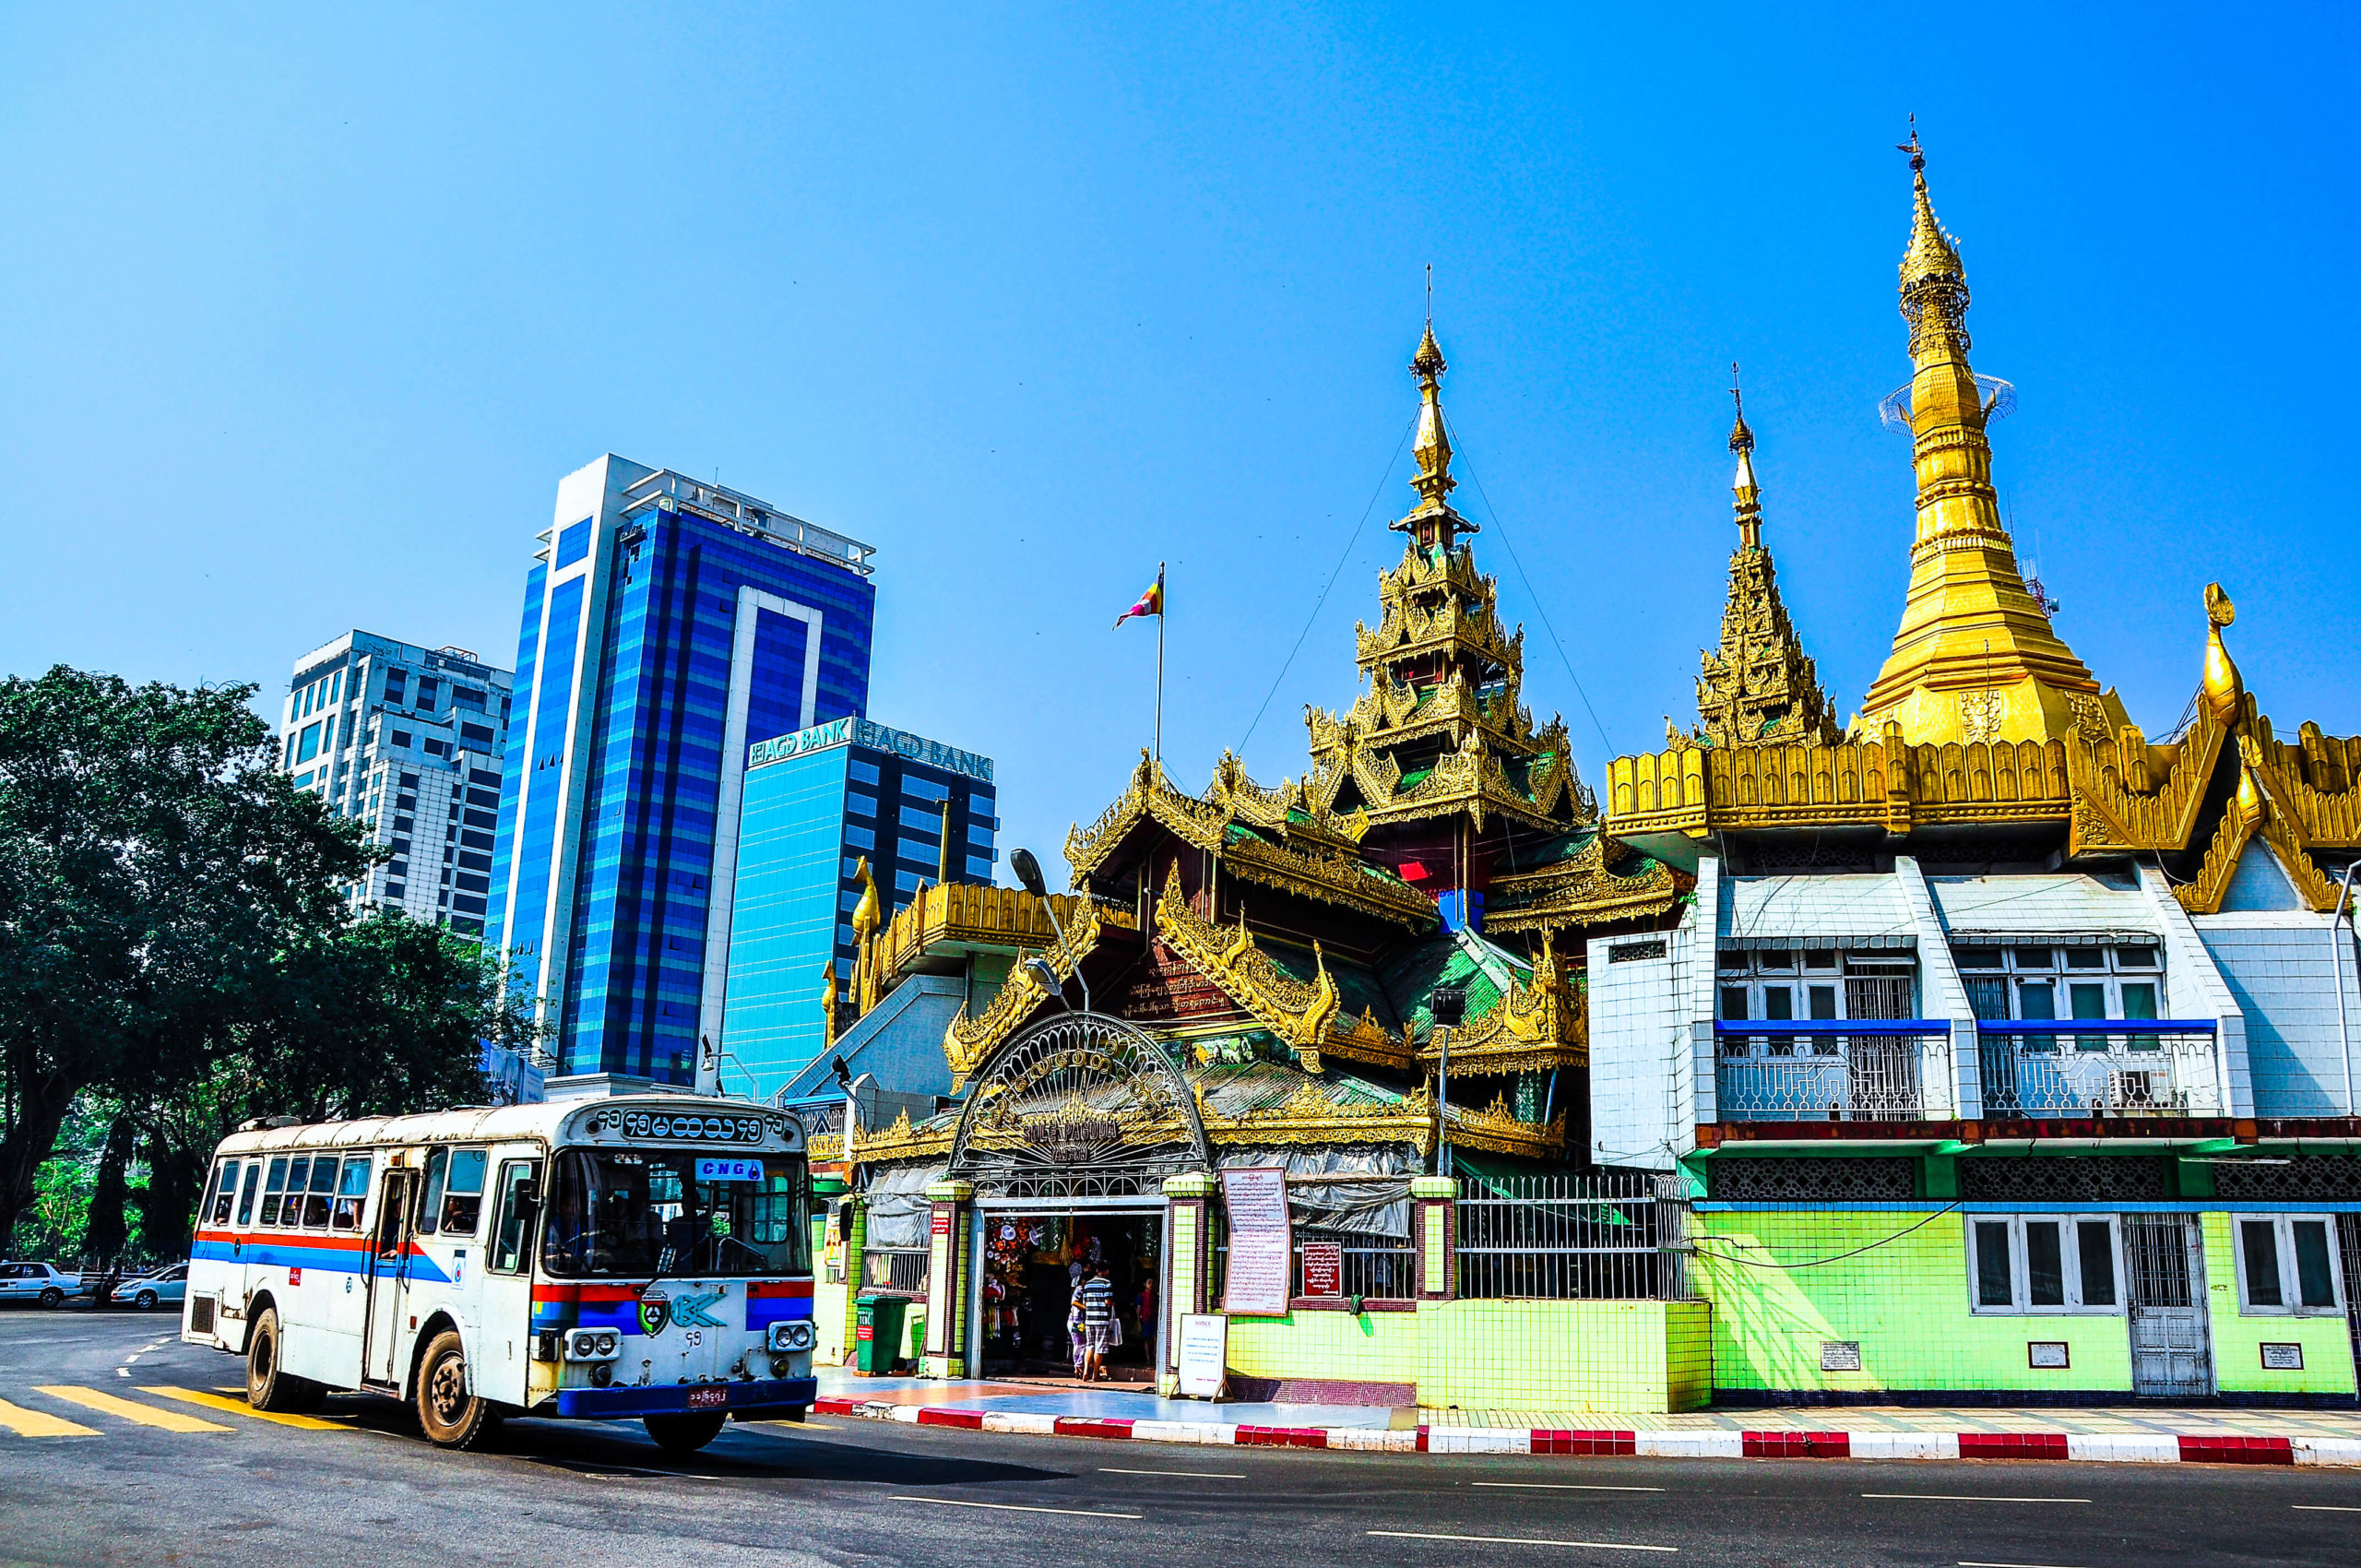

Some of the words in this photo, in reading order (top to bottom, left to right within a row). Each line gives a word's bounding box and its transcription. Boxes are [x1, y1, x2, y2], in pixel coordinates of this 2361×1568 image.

[765, 734, 797, 763] AGD
[801, 719, 848, 752] BANK
[877, 726, 923, 758] AGD
[931, 740, 991, 781] BANK
[1023, 1123, 1057, 1144] SULE
[1063, 1118, 1118, 1141] PAGODA
[703, 1162, 745, 1175] CNG
